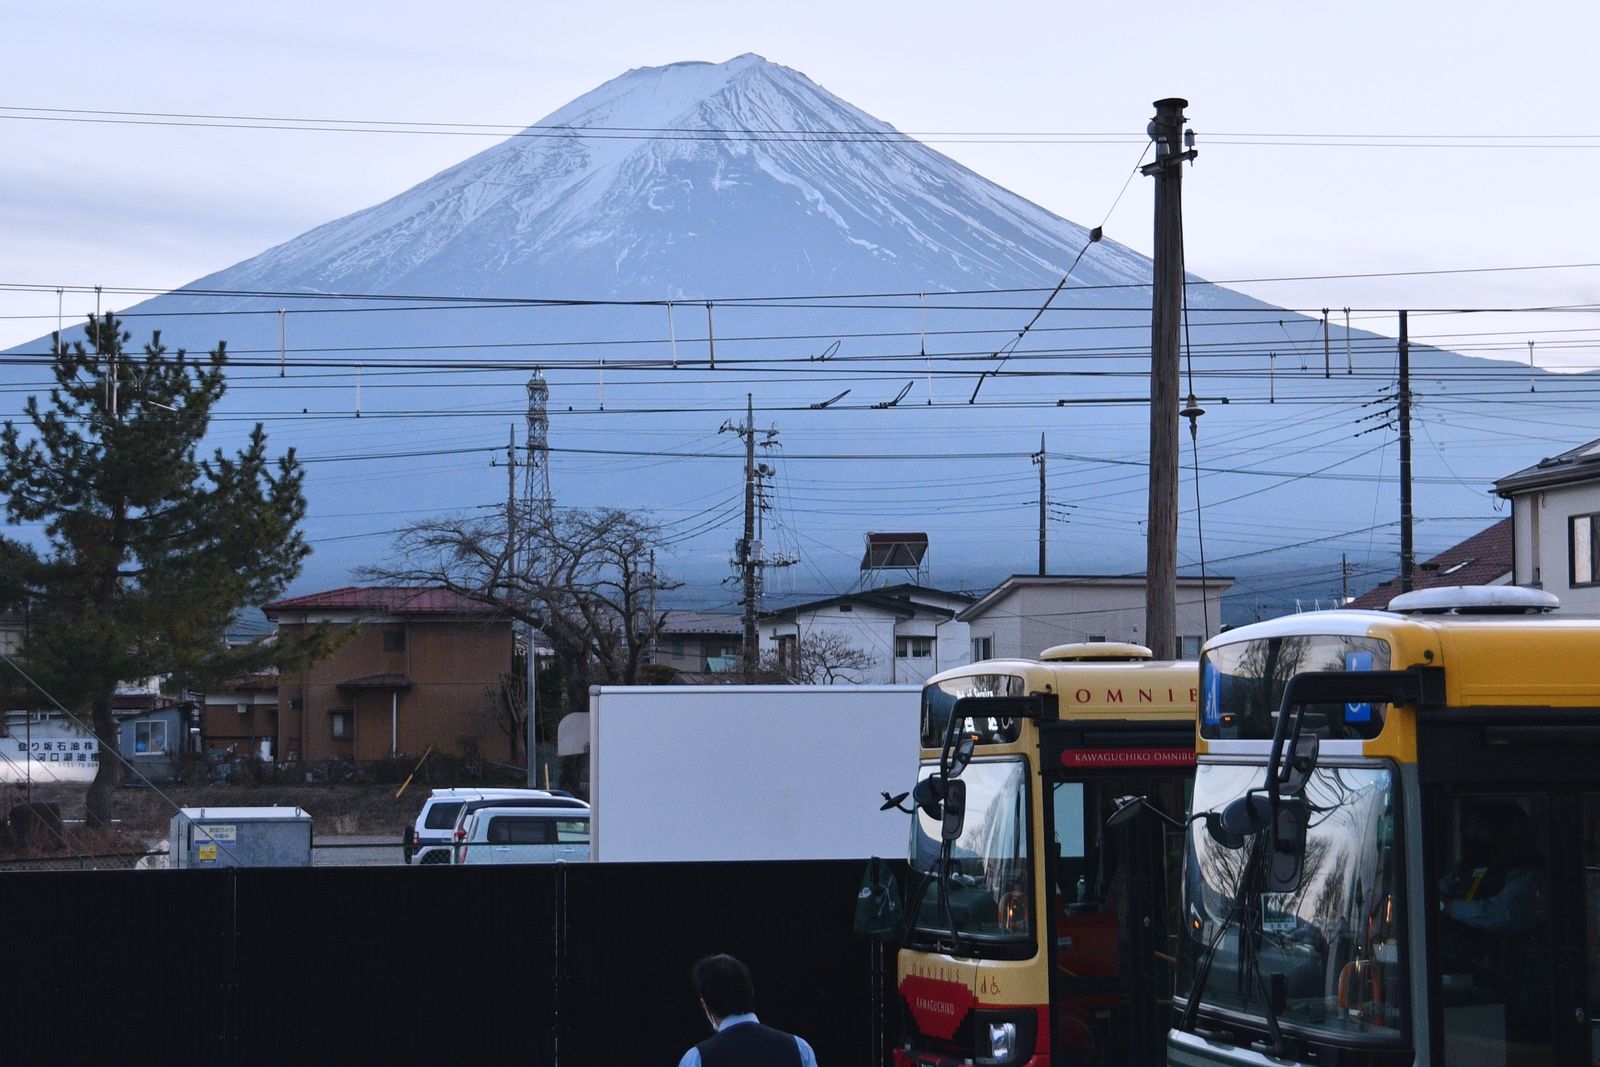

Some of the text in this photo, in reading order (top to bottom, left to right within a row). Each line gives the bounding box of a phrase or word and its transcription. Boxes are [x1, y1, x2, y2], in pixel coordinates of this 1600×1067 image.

[1075, 752, 1150, 761] KAWAGUCHIKO
[911, 962, 960, 983] OMNIBUS
[916, 997, 955, 1015] KAWAGUCHIKO
